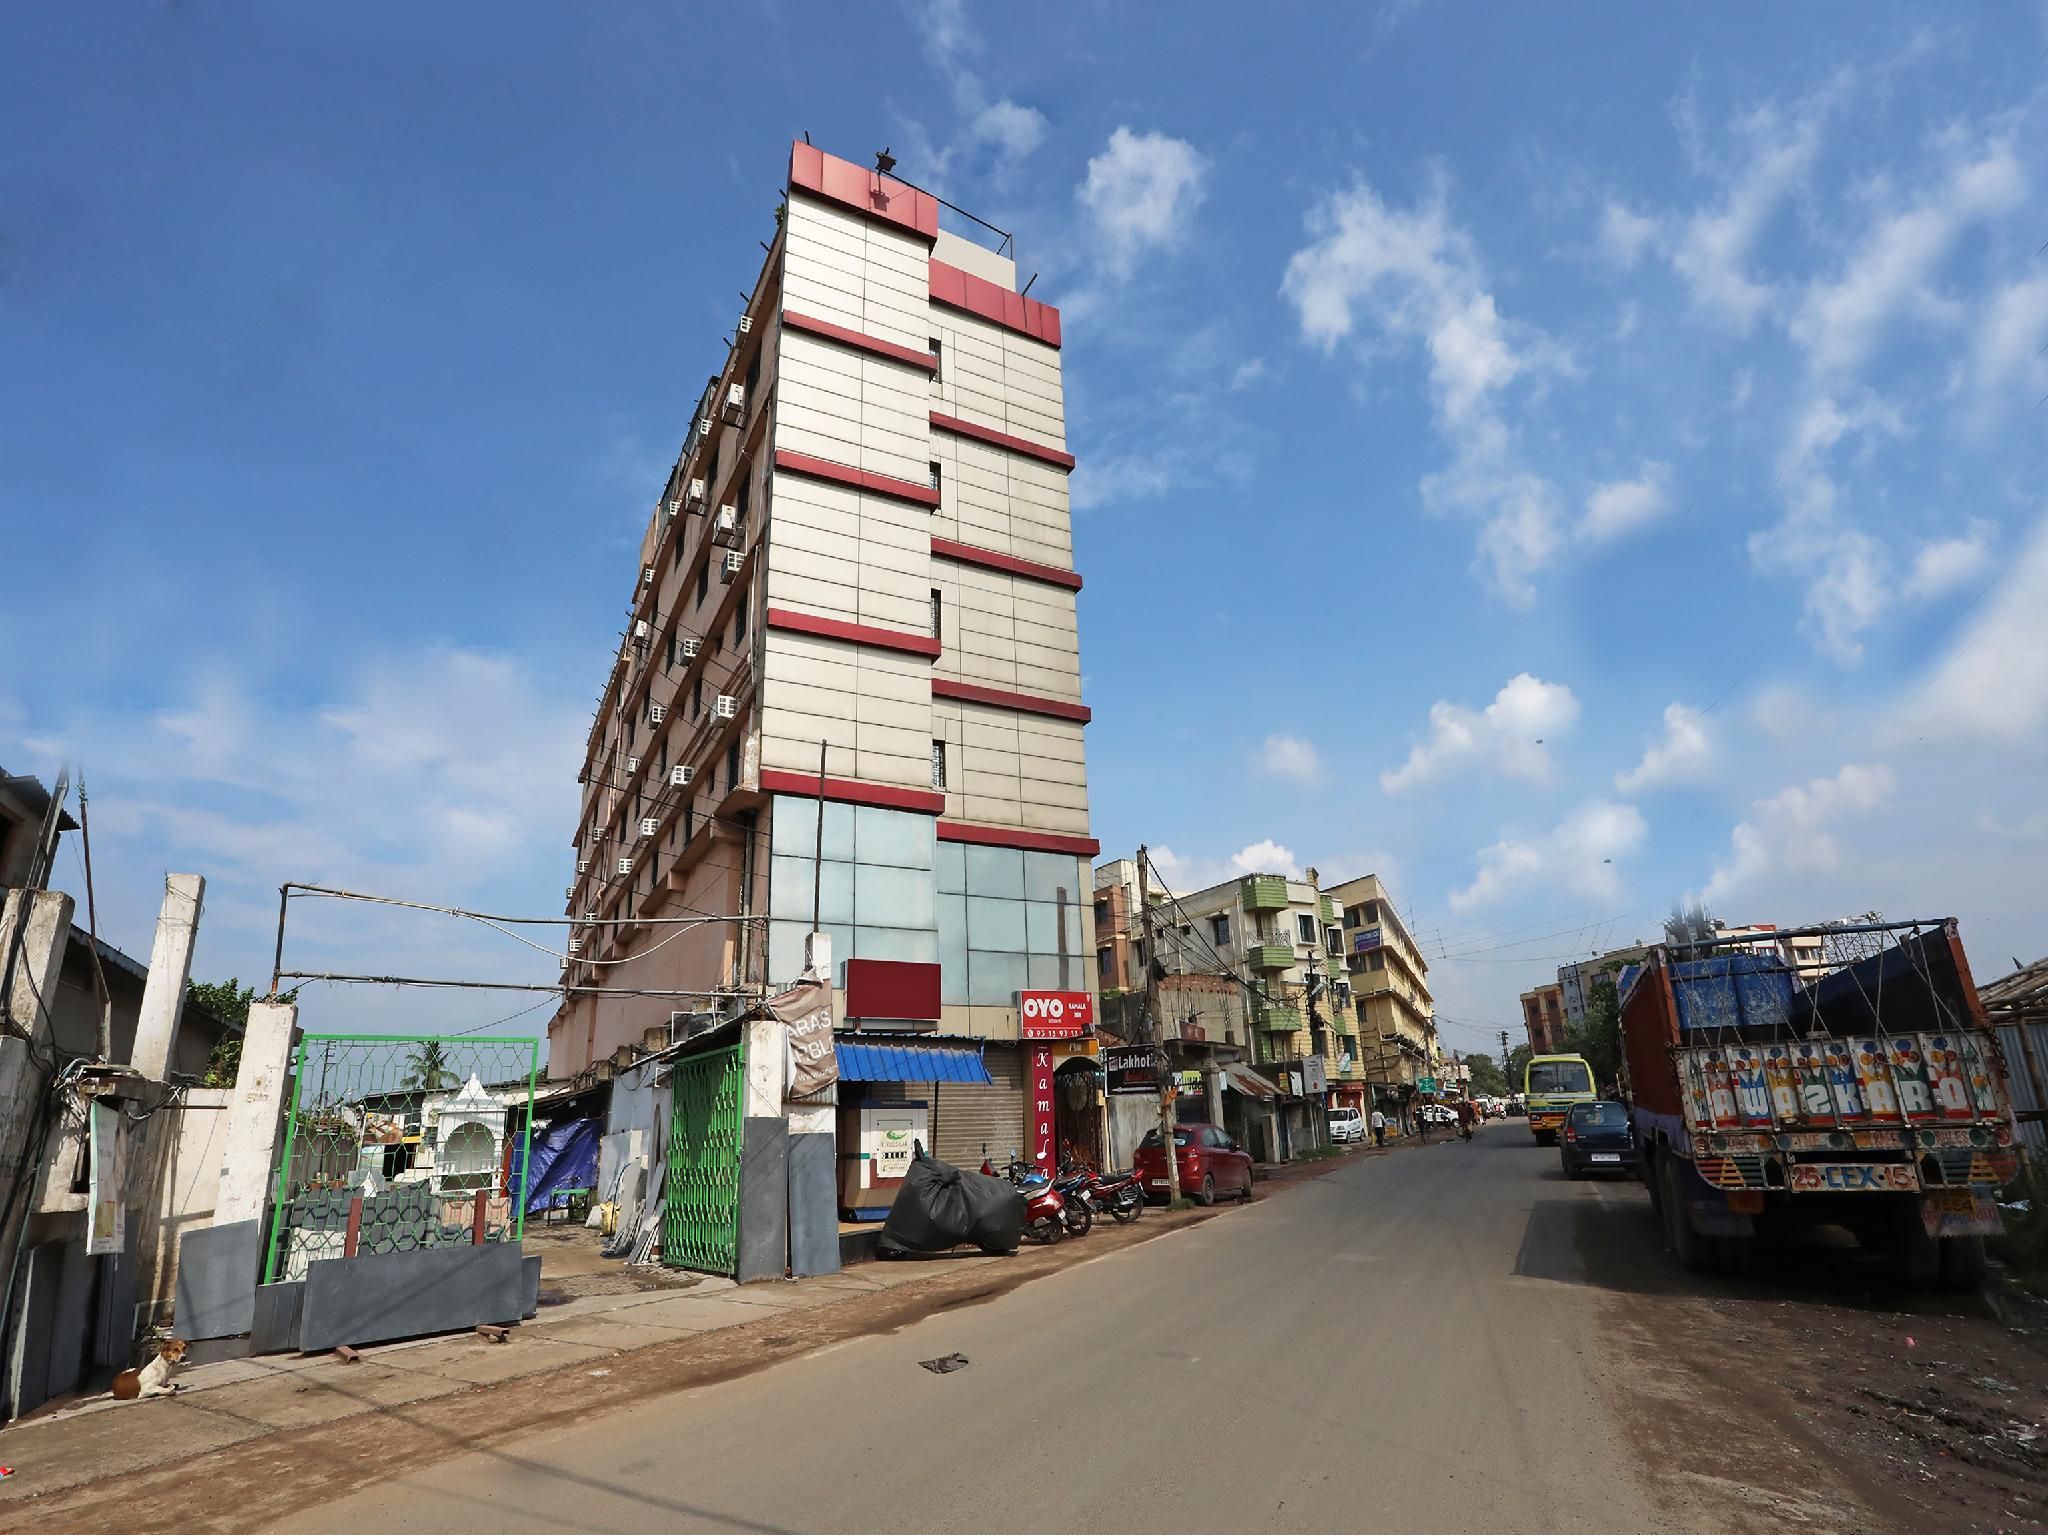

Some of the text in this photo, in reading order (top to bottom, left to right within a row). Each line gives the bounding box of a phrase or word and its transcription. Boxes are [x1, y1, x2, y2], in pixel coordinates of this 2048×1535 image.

[1024, 998, 1064, 1018] OYO
[1793, 1165, 1914, 1188] 25 CEX 15
